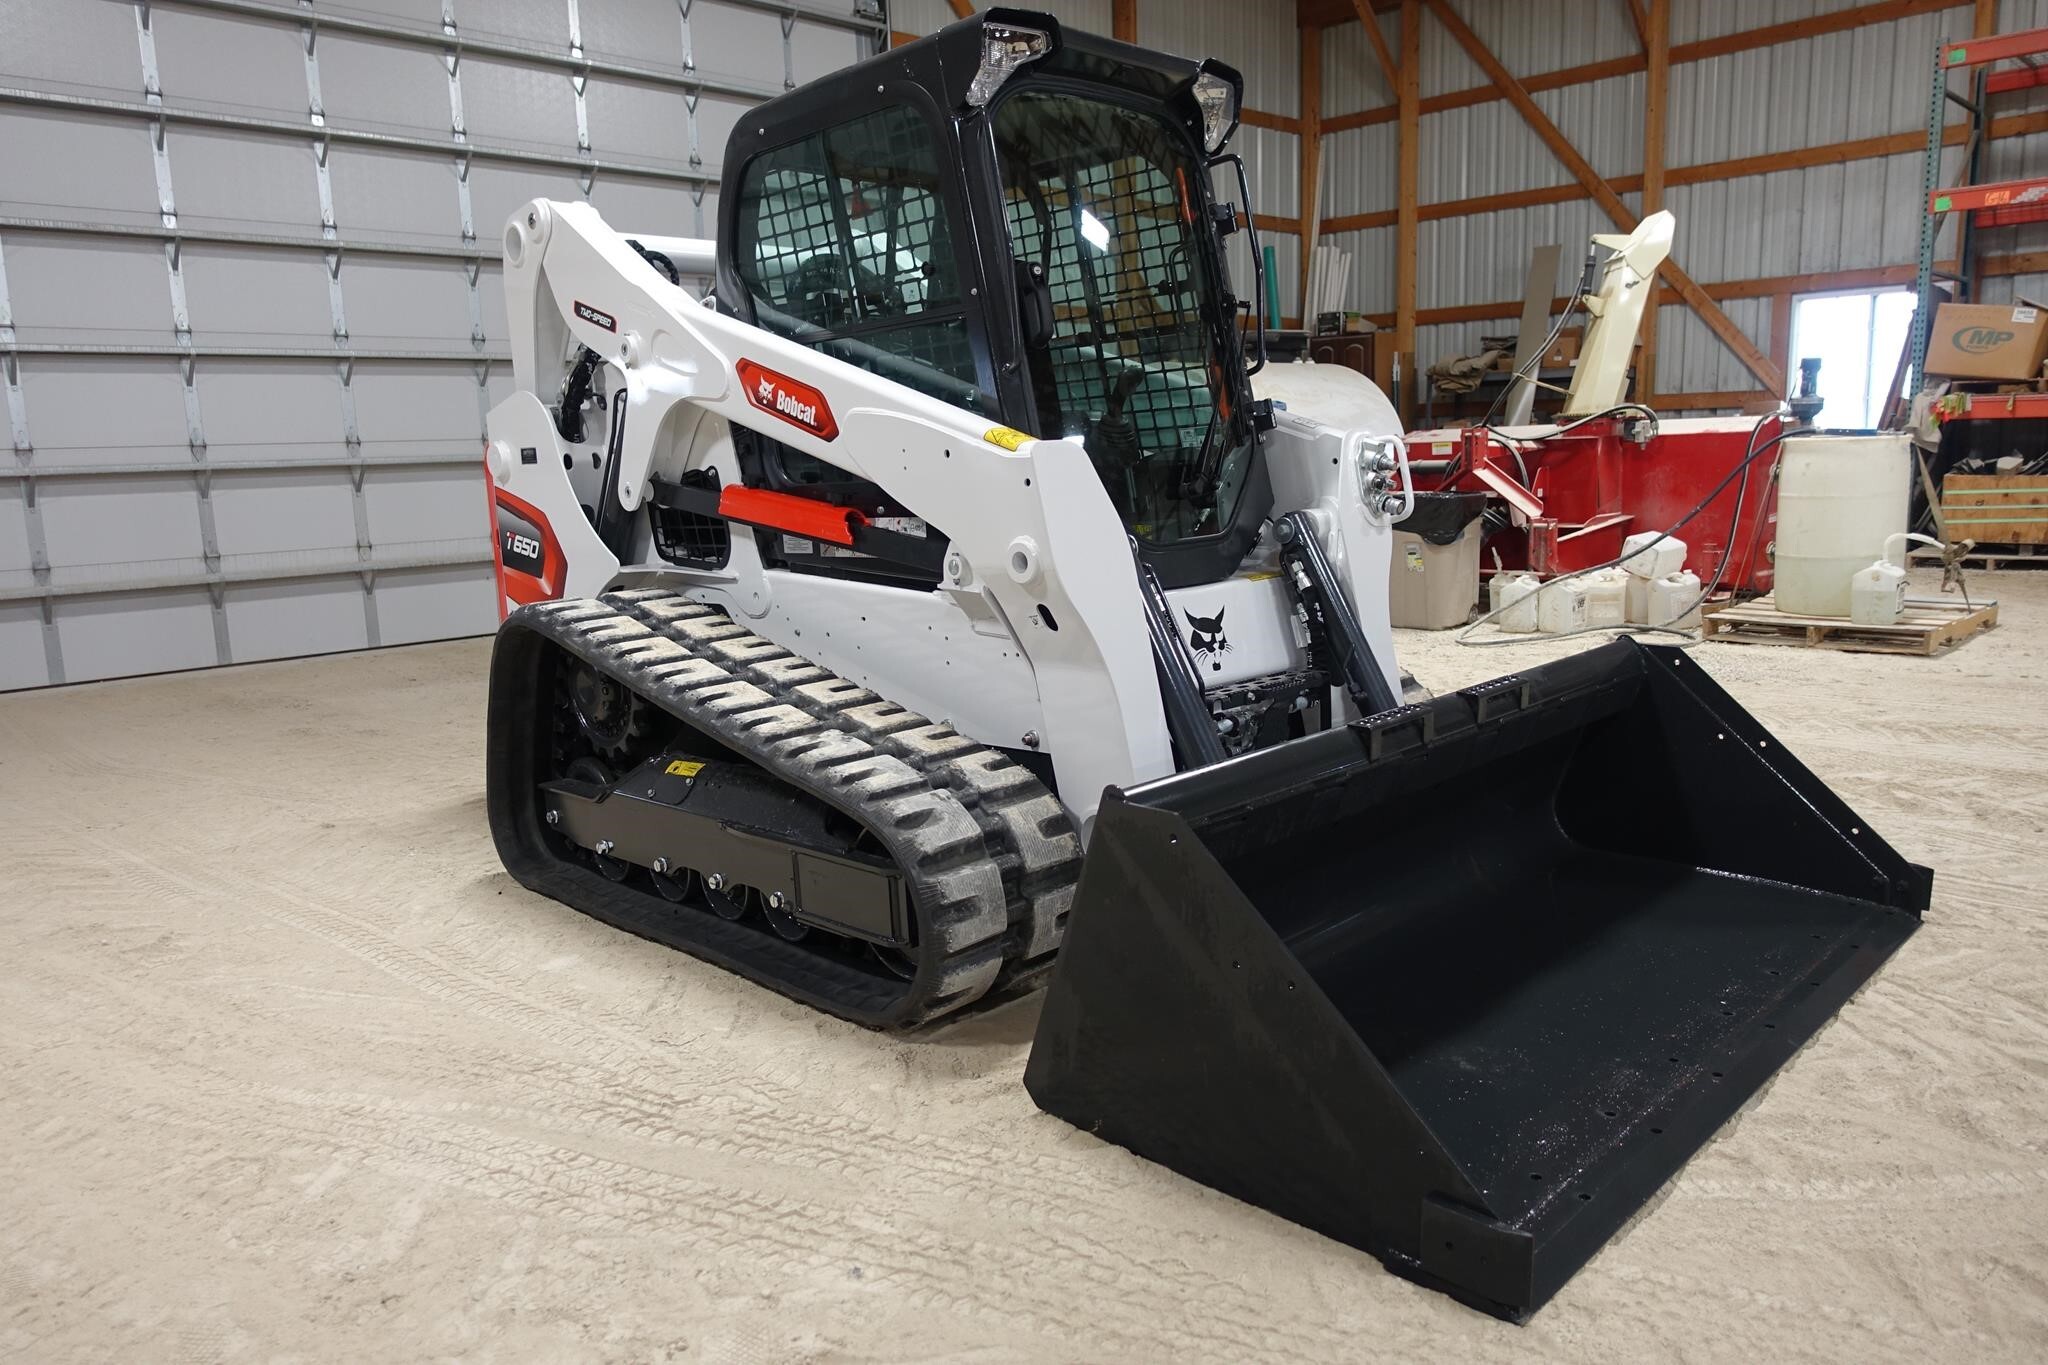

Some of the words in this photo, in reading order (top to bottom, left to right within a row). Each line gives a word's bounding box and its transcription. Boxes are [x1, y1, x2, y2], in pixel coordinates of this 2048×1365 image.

[580, 306, 612, 327] TWO-SPEED
[776, 389, 817, 426] Bobcat
[506, 531, 540, 559] T650
